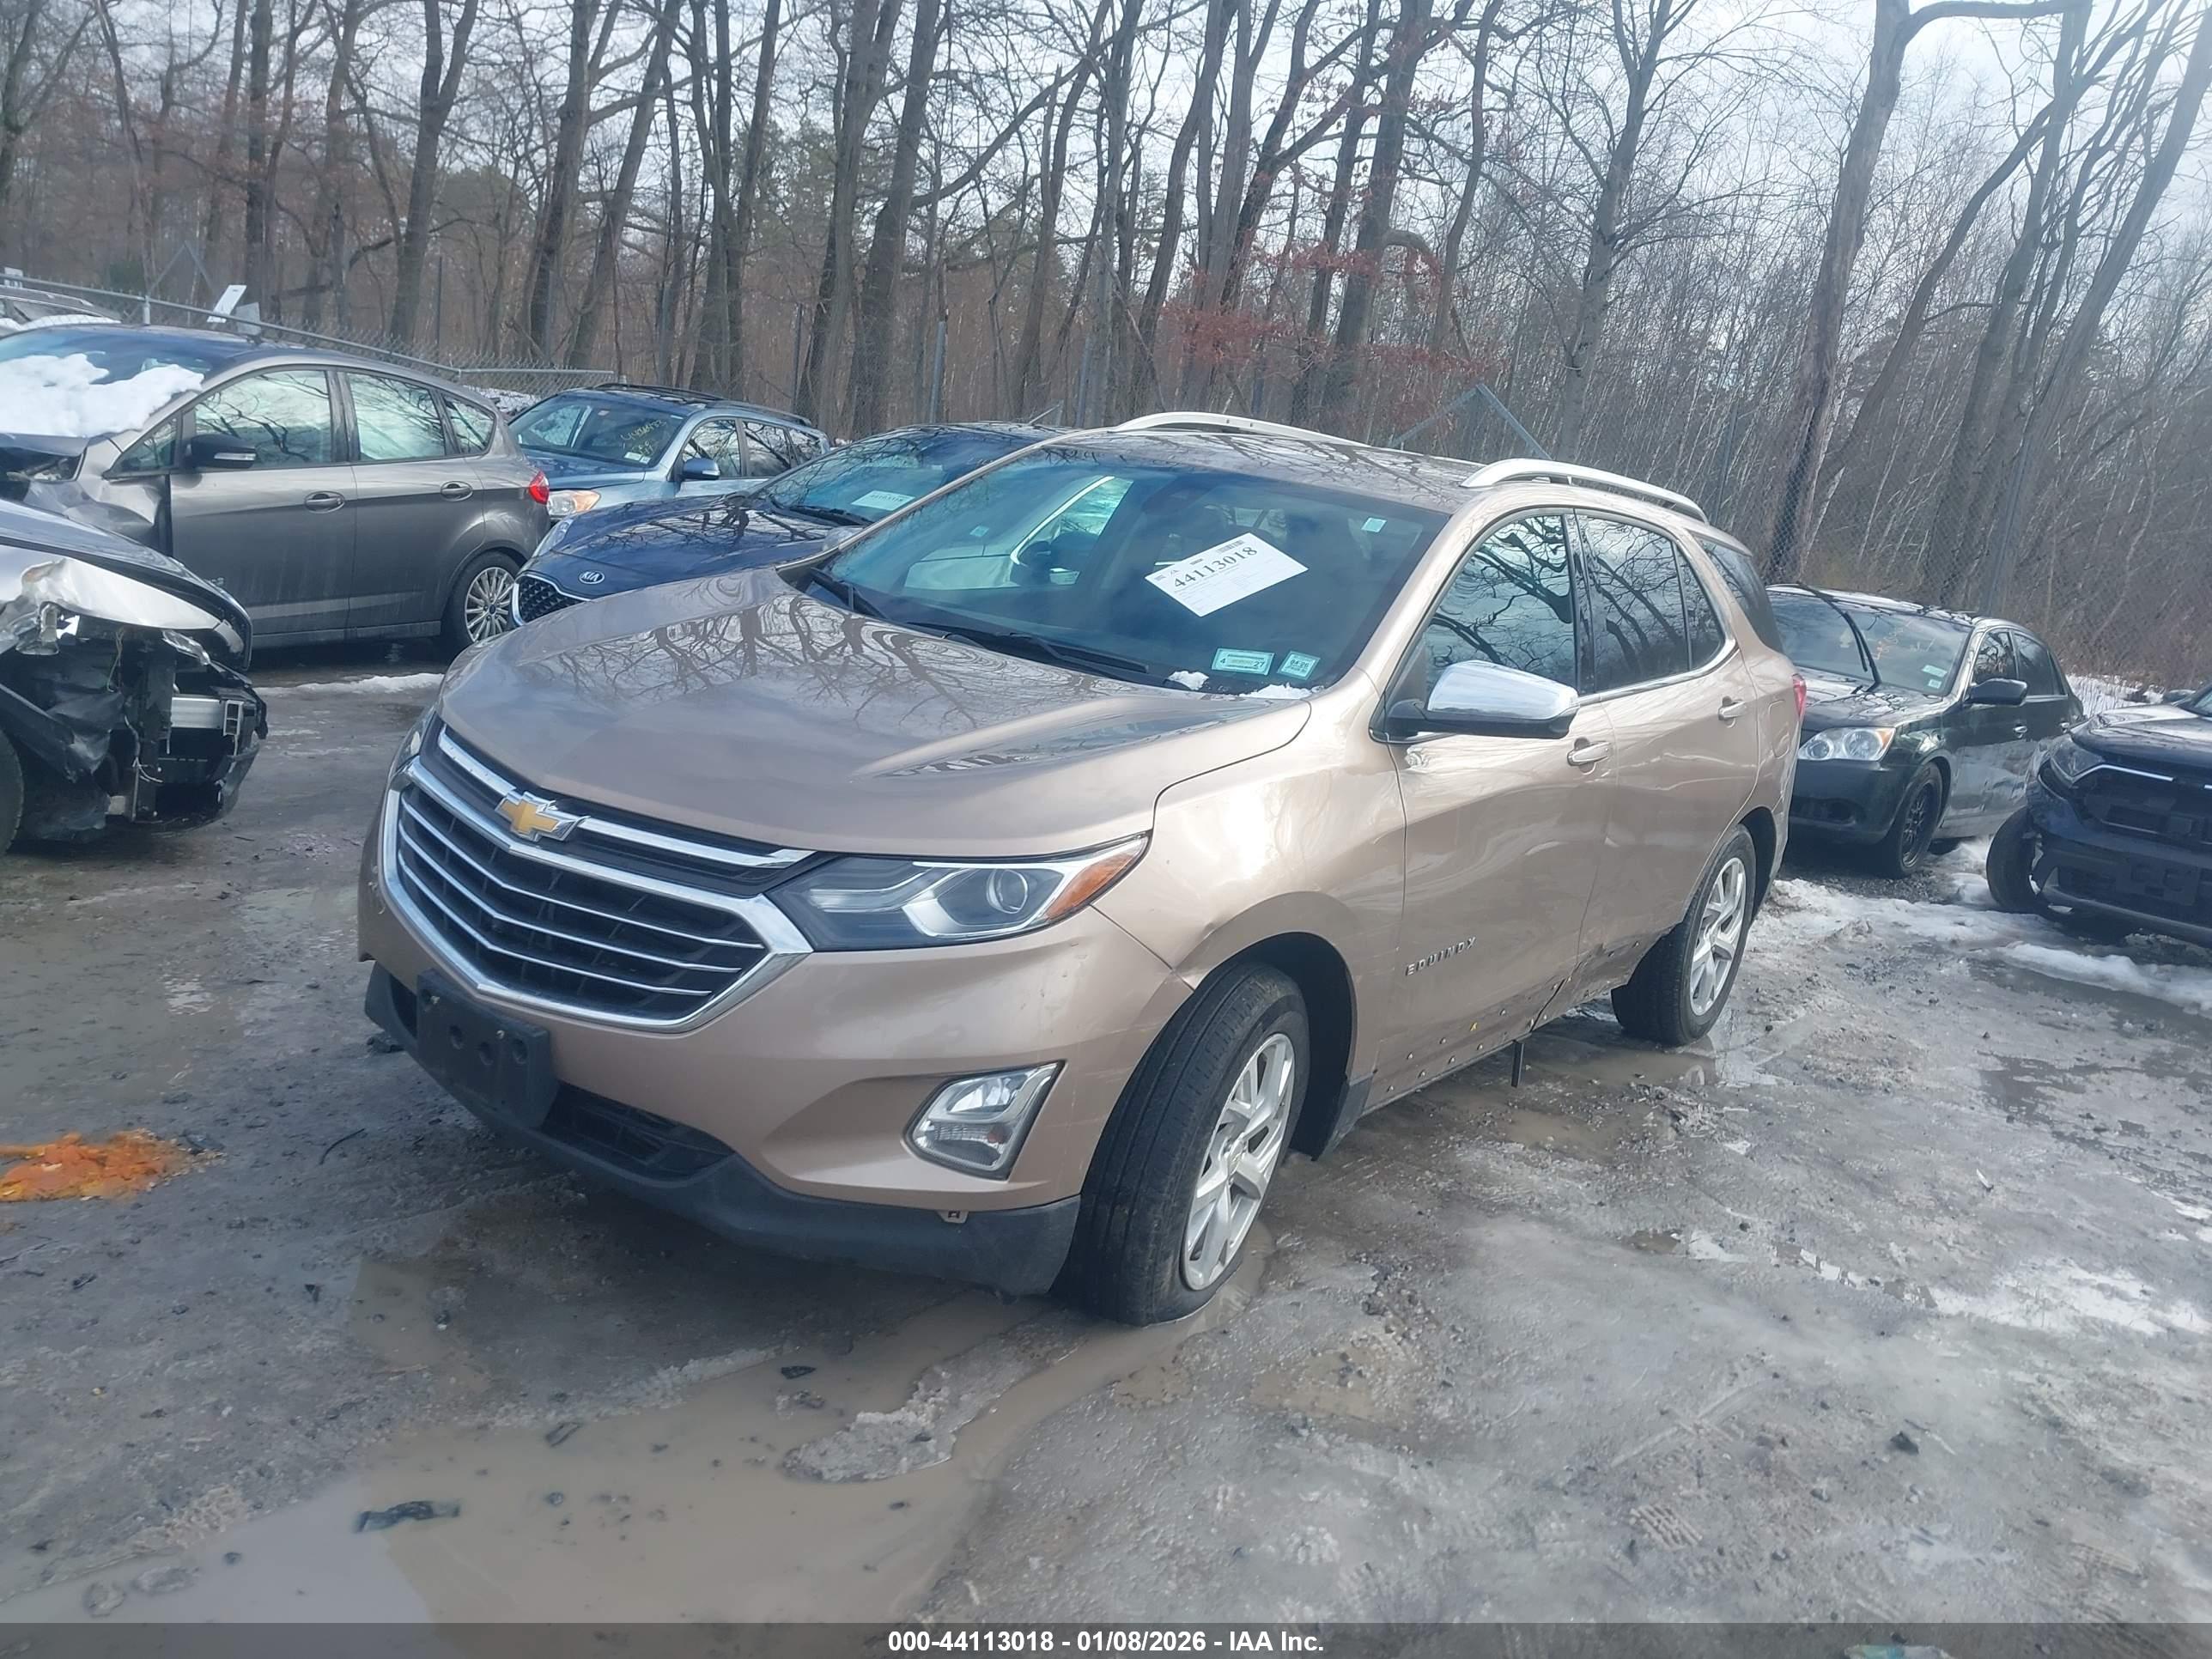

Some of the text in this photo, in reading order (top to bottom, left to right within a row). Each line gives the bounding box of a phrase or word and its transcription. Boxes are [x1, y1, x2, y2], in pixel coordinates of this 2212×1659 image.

[580, 571, 600, 582] KIA
[1175, 547, 1258, 587] 44113018
[1405, 936, 1476, 976] EQUINOX
